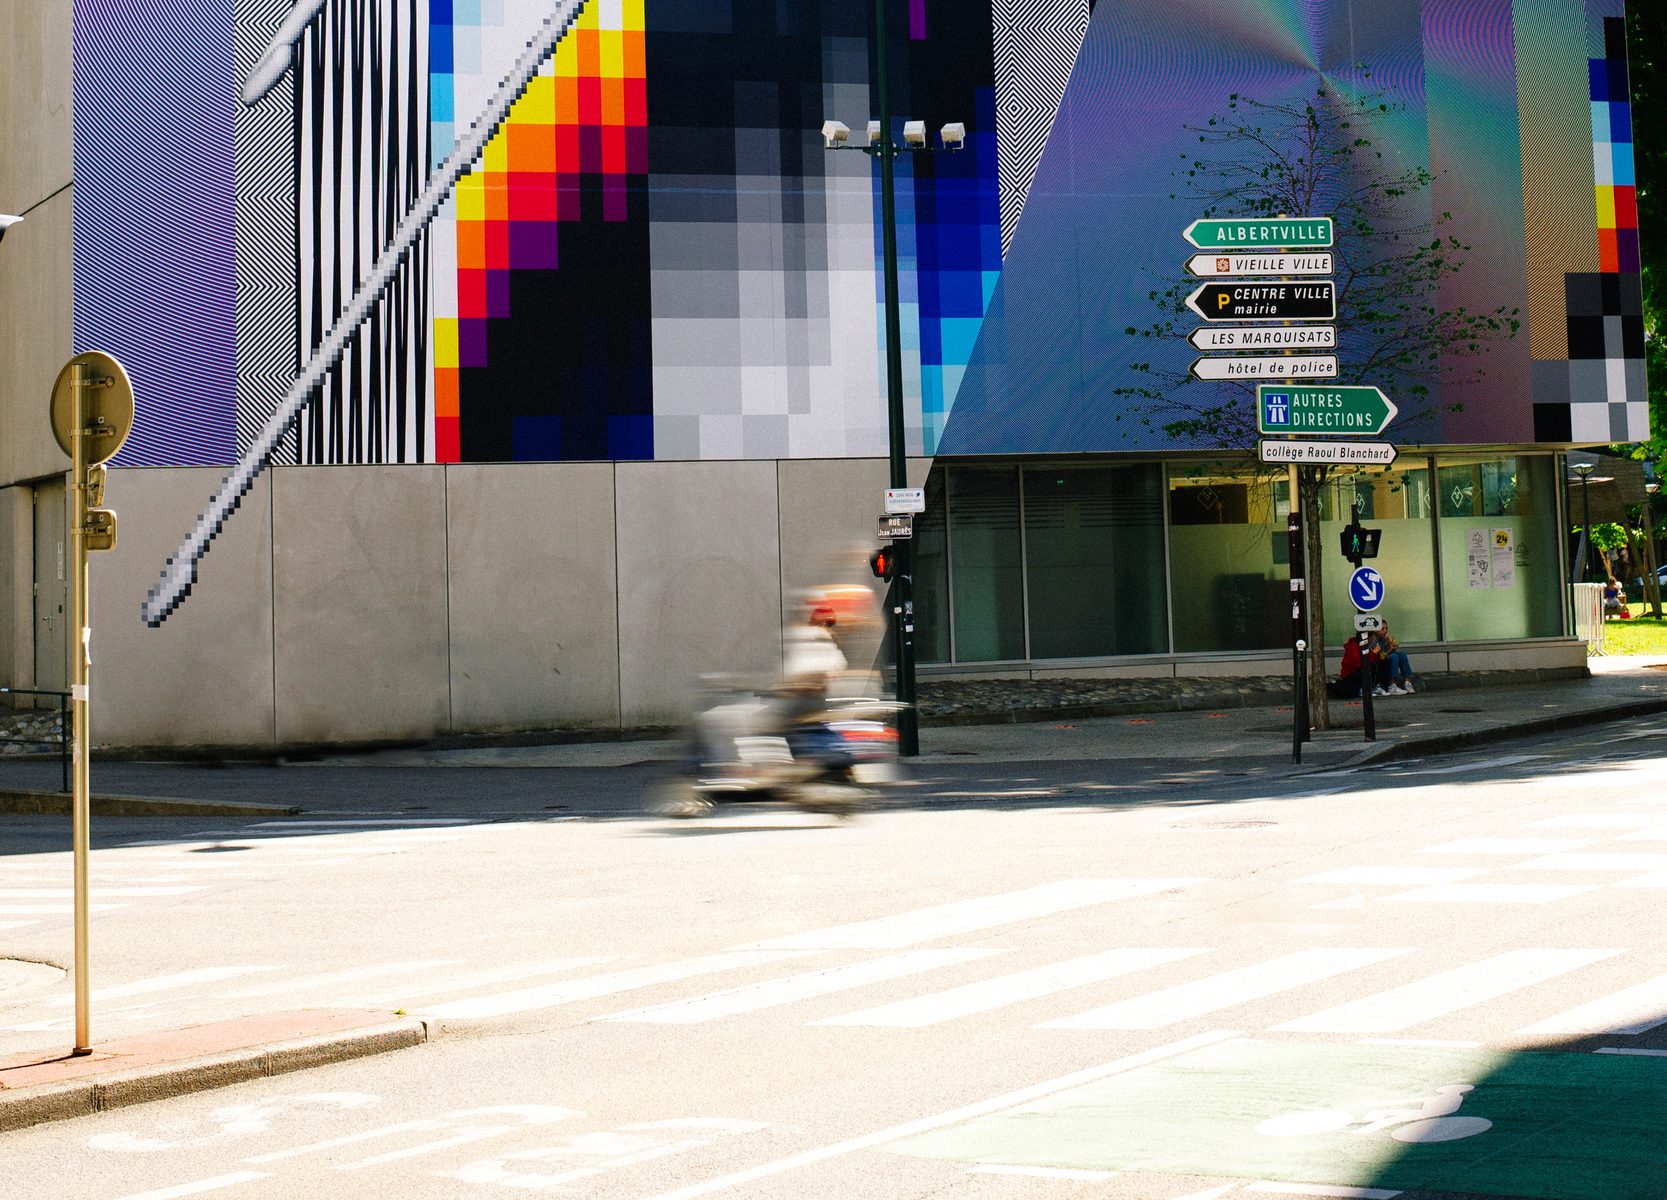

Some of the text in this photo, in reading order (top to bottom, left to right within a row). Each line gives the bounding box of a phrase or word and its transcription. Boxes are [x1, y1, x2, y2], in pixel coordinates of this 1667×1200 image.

[1217, 226, 1325, 241] ALBERTVILLE
[1235, 258, 1329, 270] VIEILLE VILLE
[1234, 287, 1330, 300] CENTRE VILLE
[1218, 294, 1230, 309] P
[1234, 303, 1277, 315] mairie
[1211, 331, 1331, 344] LES MARQUISATS
[1228, 361, 1333, 376] hôtel de police
[1293, 394, 1342, 407] AUTRES
[1293, 413, 1373, 426] DIRECTIONS
[1266, 446, 1389, 459] collège Raoul Blanchard
[1496, 535, 1508, 543] 24
